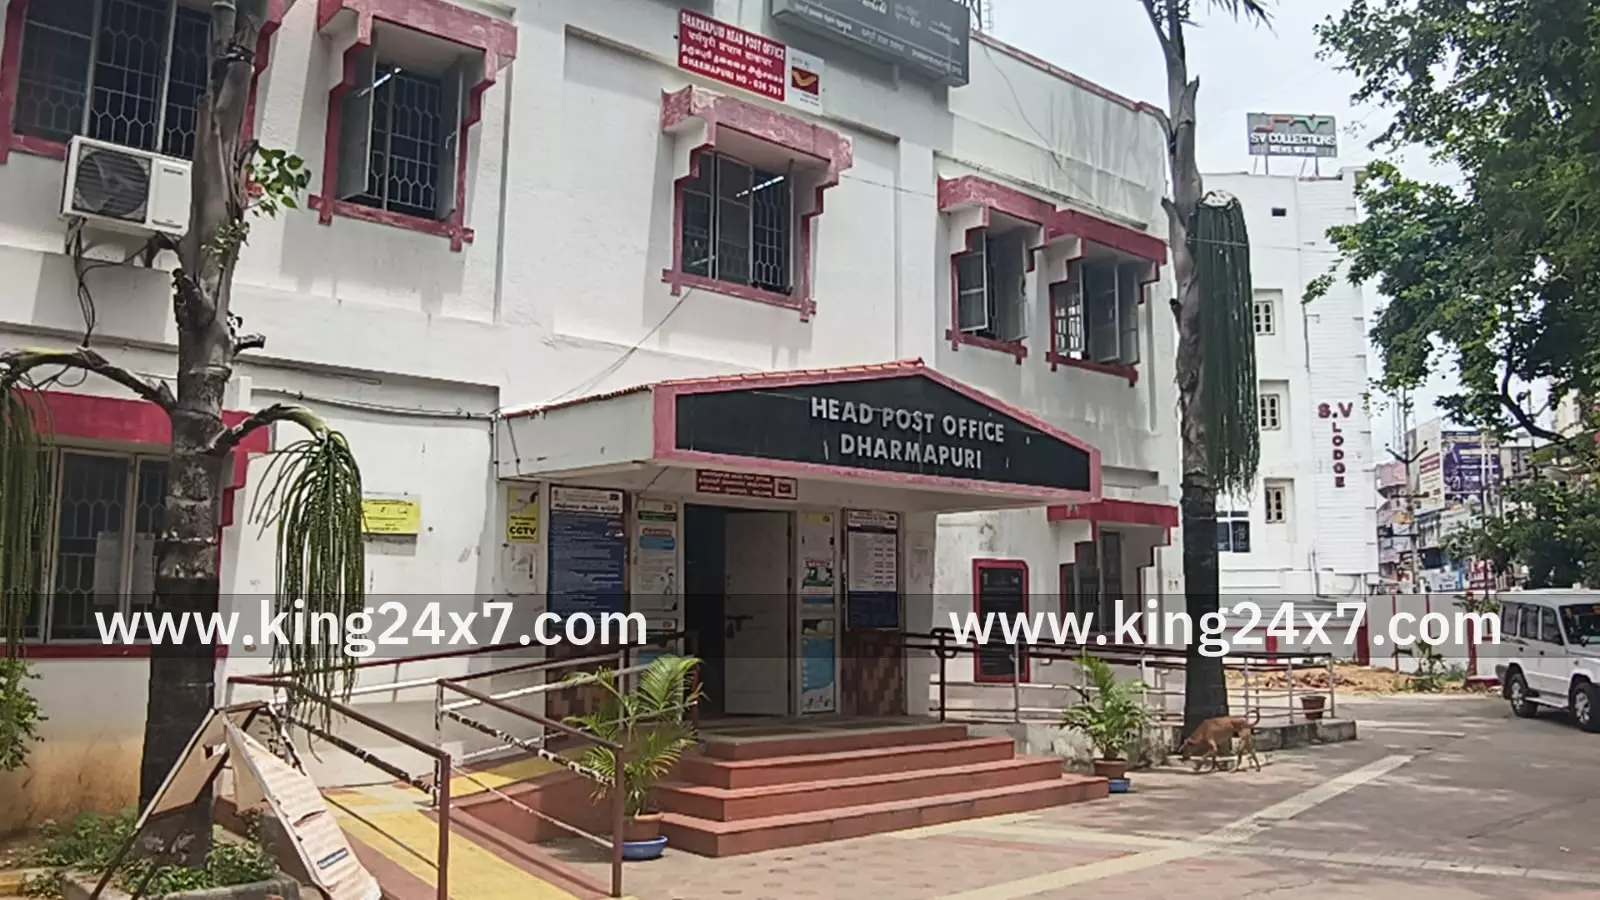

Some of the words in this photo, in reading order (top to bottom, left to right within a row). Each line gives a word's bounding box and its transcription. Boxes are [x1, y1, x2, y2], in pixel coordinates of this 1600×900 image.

[681, 12, 725, 39] DHARMAPURI
[726, 28, 743, 46] HEAD
[745, 35, 761, 53] POST
[762, 41, 785, 61] OFFICE
[682, 56, 735, 81] DHARMAPURI
[735, 73, 747, 85] HO
[1250, 132, 1266, 144] SV
[1268, 132, 1336, 146] COLLECTIONS
[812, 397, 873, 425] HEAD
[882, 408, 935, 432] POST
[942, 416, 1004, 442] OFFICE
[1318, 402, 1353, 419] S.V
[840, 433, 981, 469] DHARMAPURI
[509, 526, 537, 535] CCTV
